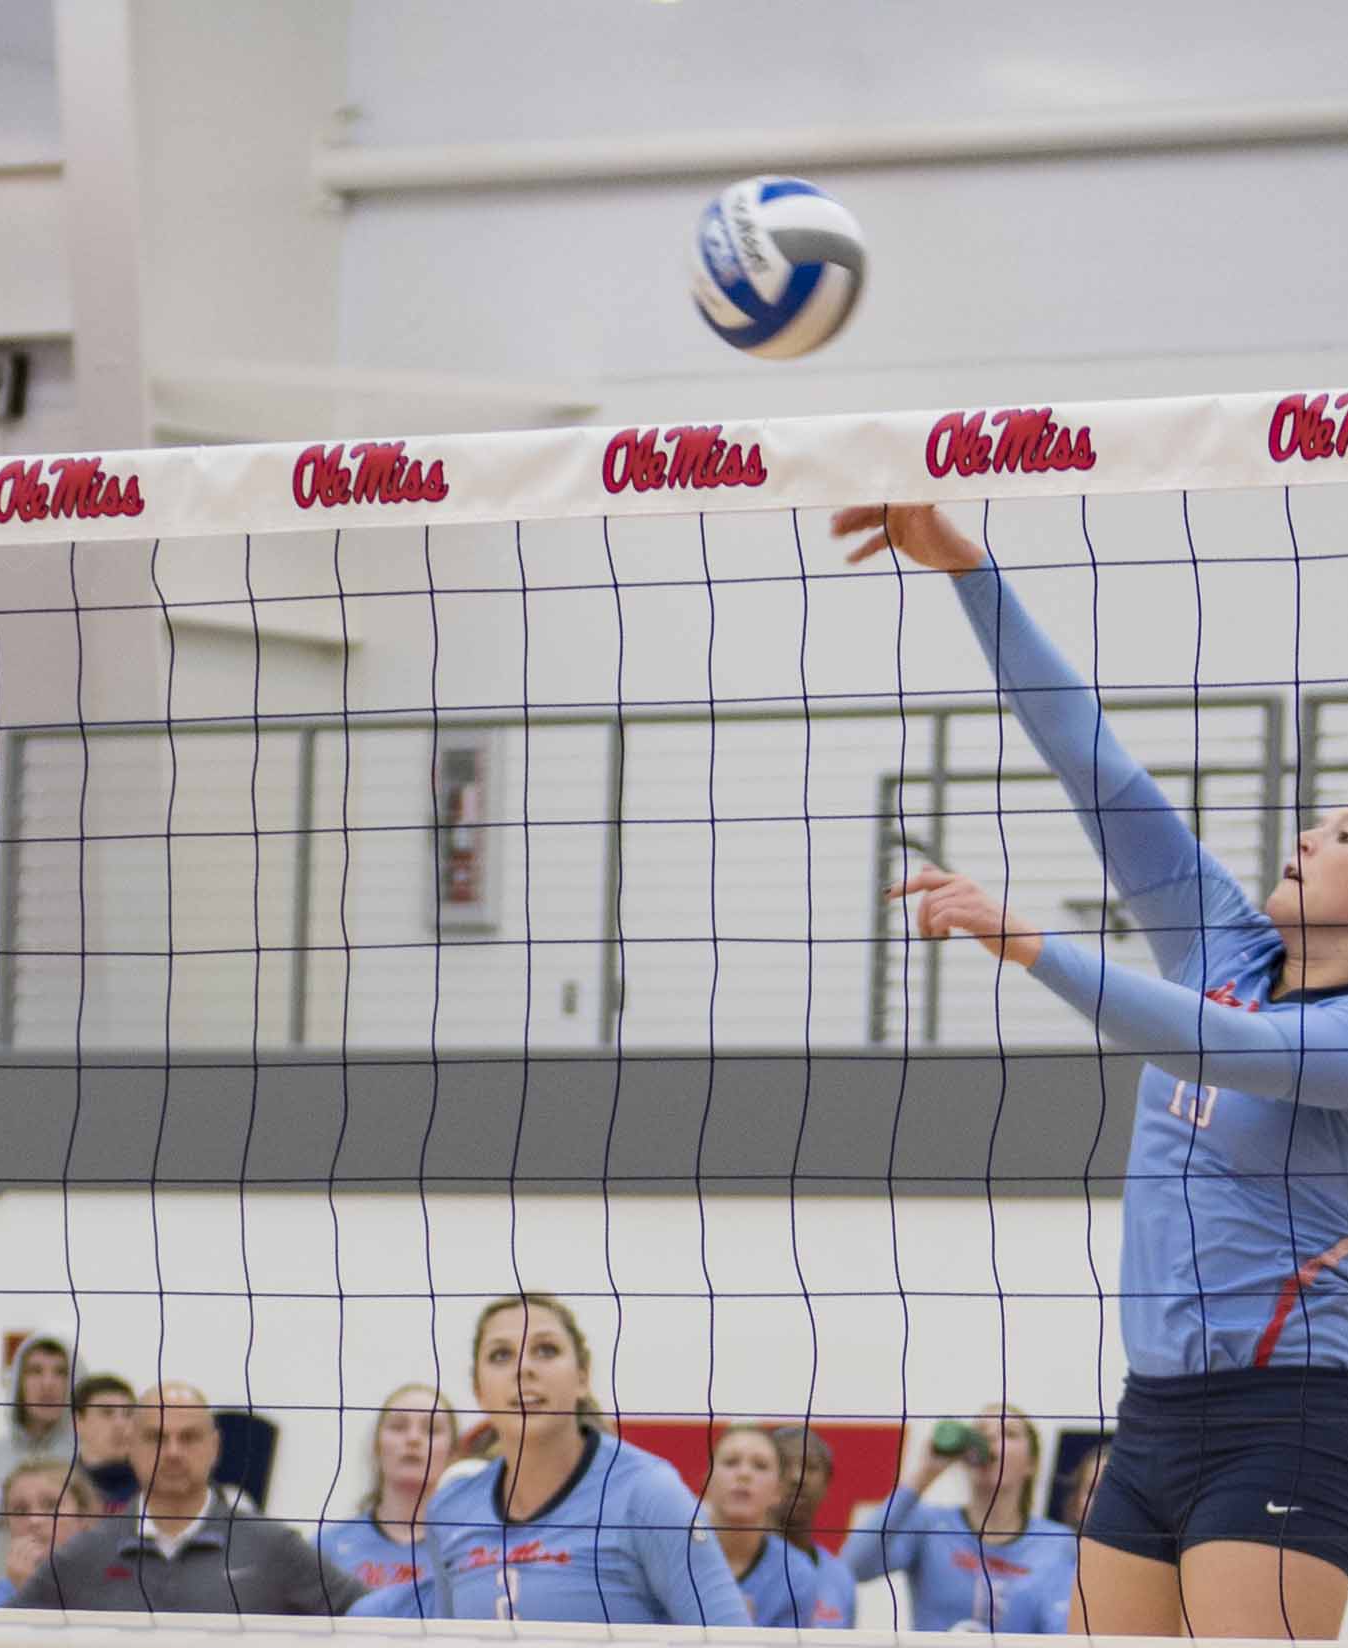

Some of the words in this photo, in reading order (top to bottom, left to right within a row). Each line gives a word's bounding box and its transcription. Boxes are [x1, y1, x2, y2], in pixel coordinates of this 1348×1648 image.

[603, 427, 666, 495] Ole
[666, 425, 768, 490] Miss
[926, 410, 991, 479] Ole
[991, 408, 1097, 474] Miss
[1268, 391, 1336, 463] Ole
[50, 458, 145, 520] Miss
[293, 444, 352, 510] Ole
[352, 442, 449, 506] Miss
